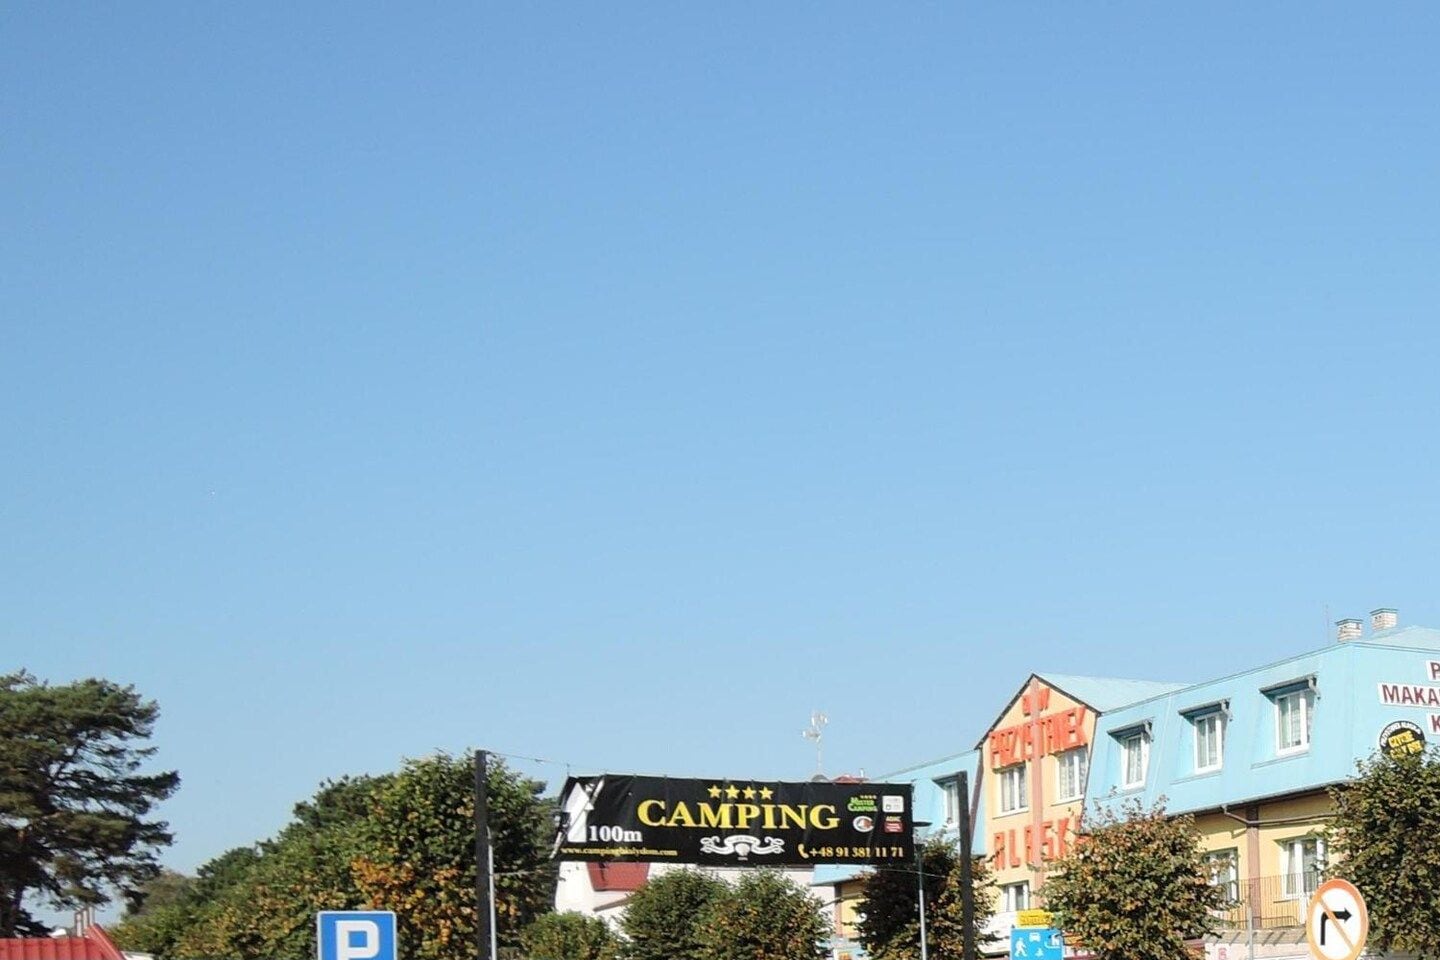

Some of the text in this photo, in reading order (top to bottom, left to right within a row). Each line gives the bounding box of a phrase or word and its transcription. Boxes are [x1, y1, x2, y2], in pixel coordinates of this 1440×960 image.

[637, 799, 841, 830] CAMPING
[589, 825, 643, 842] 100m
[809, 846, 904, 858] +48 91 381 11 71
